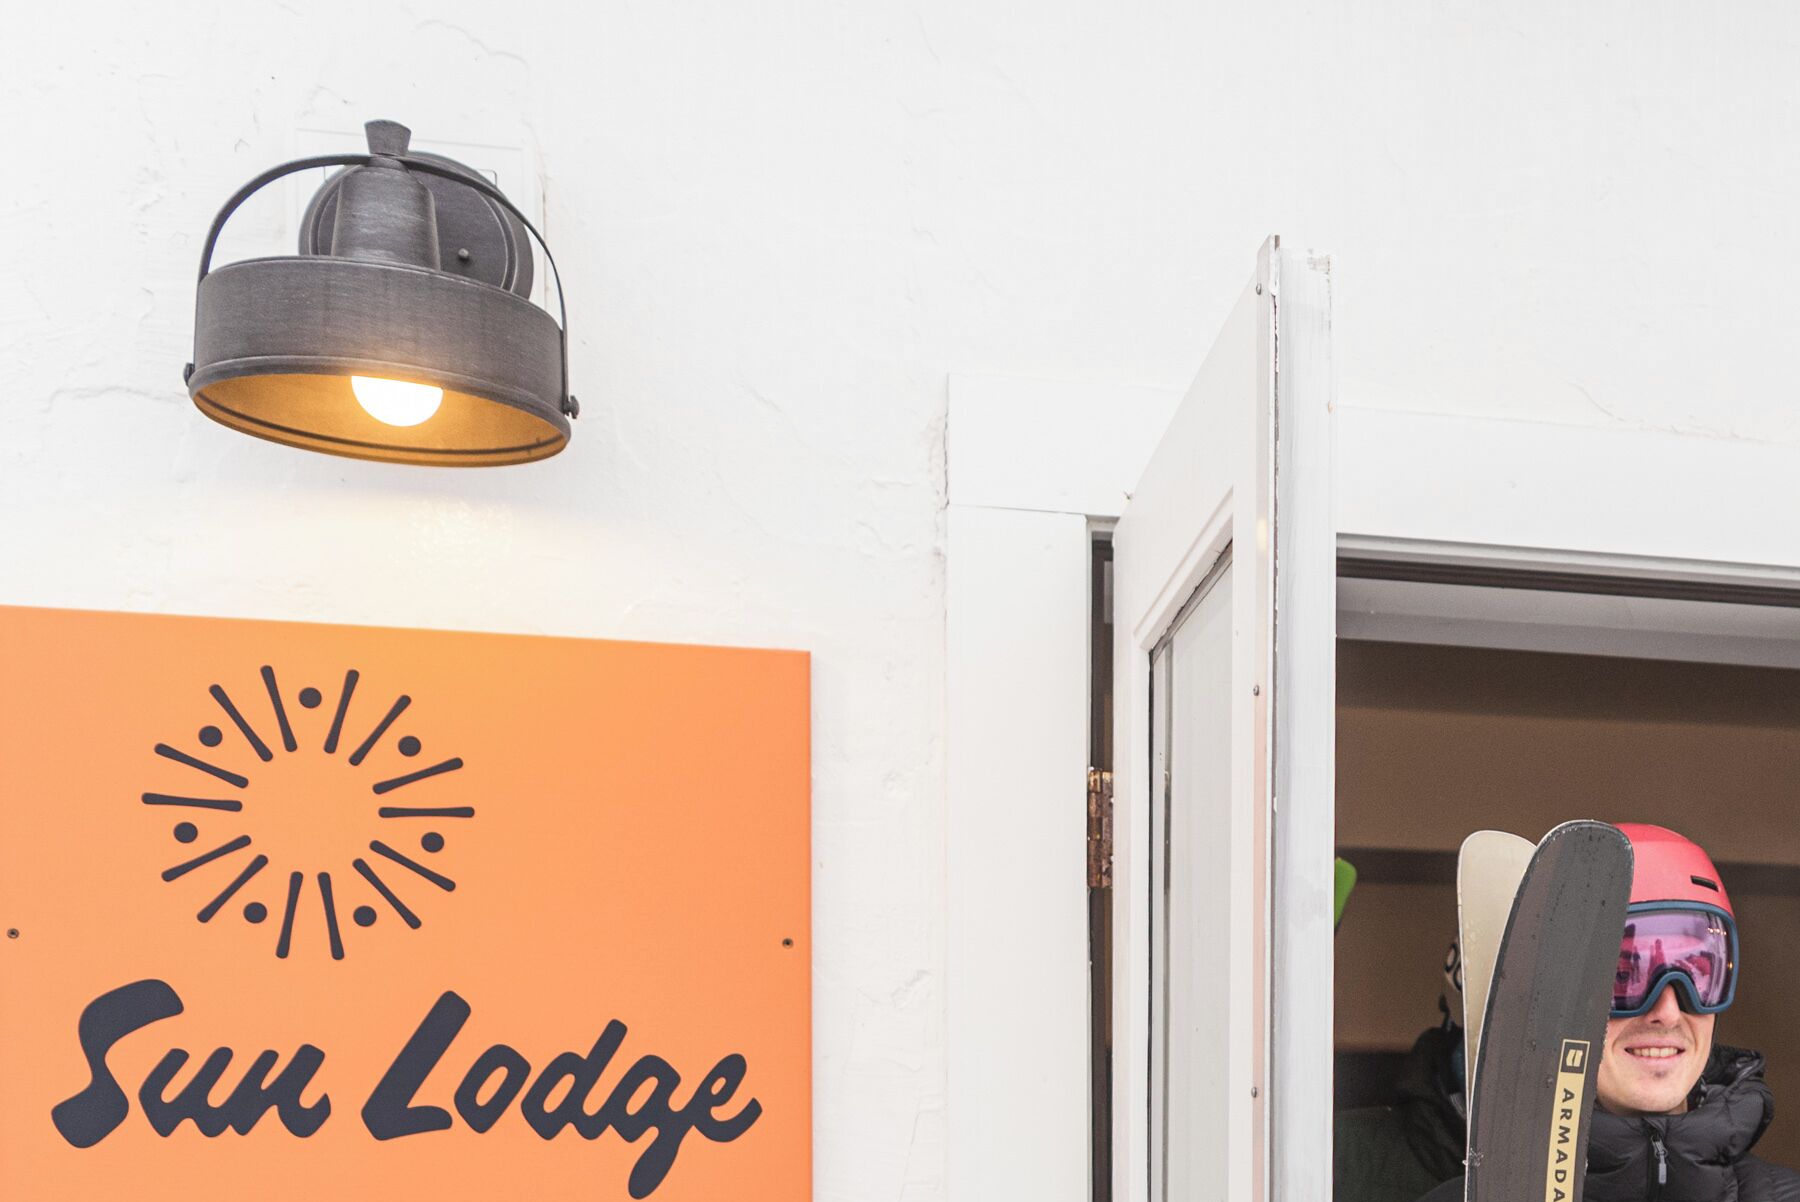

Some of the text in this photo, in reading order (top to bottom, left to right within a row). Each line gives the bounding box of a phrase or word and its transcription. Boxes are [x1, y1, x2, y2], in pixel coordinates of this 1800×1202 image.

[51, 978, 763, 1201] Sun Lodge
[1553, 1088, 1575, 1202] ARMADA
